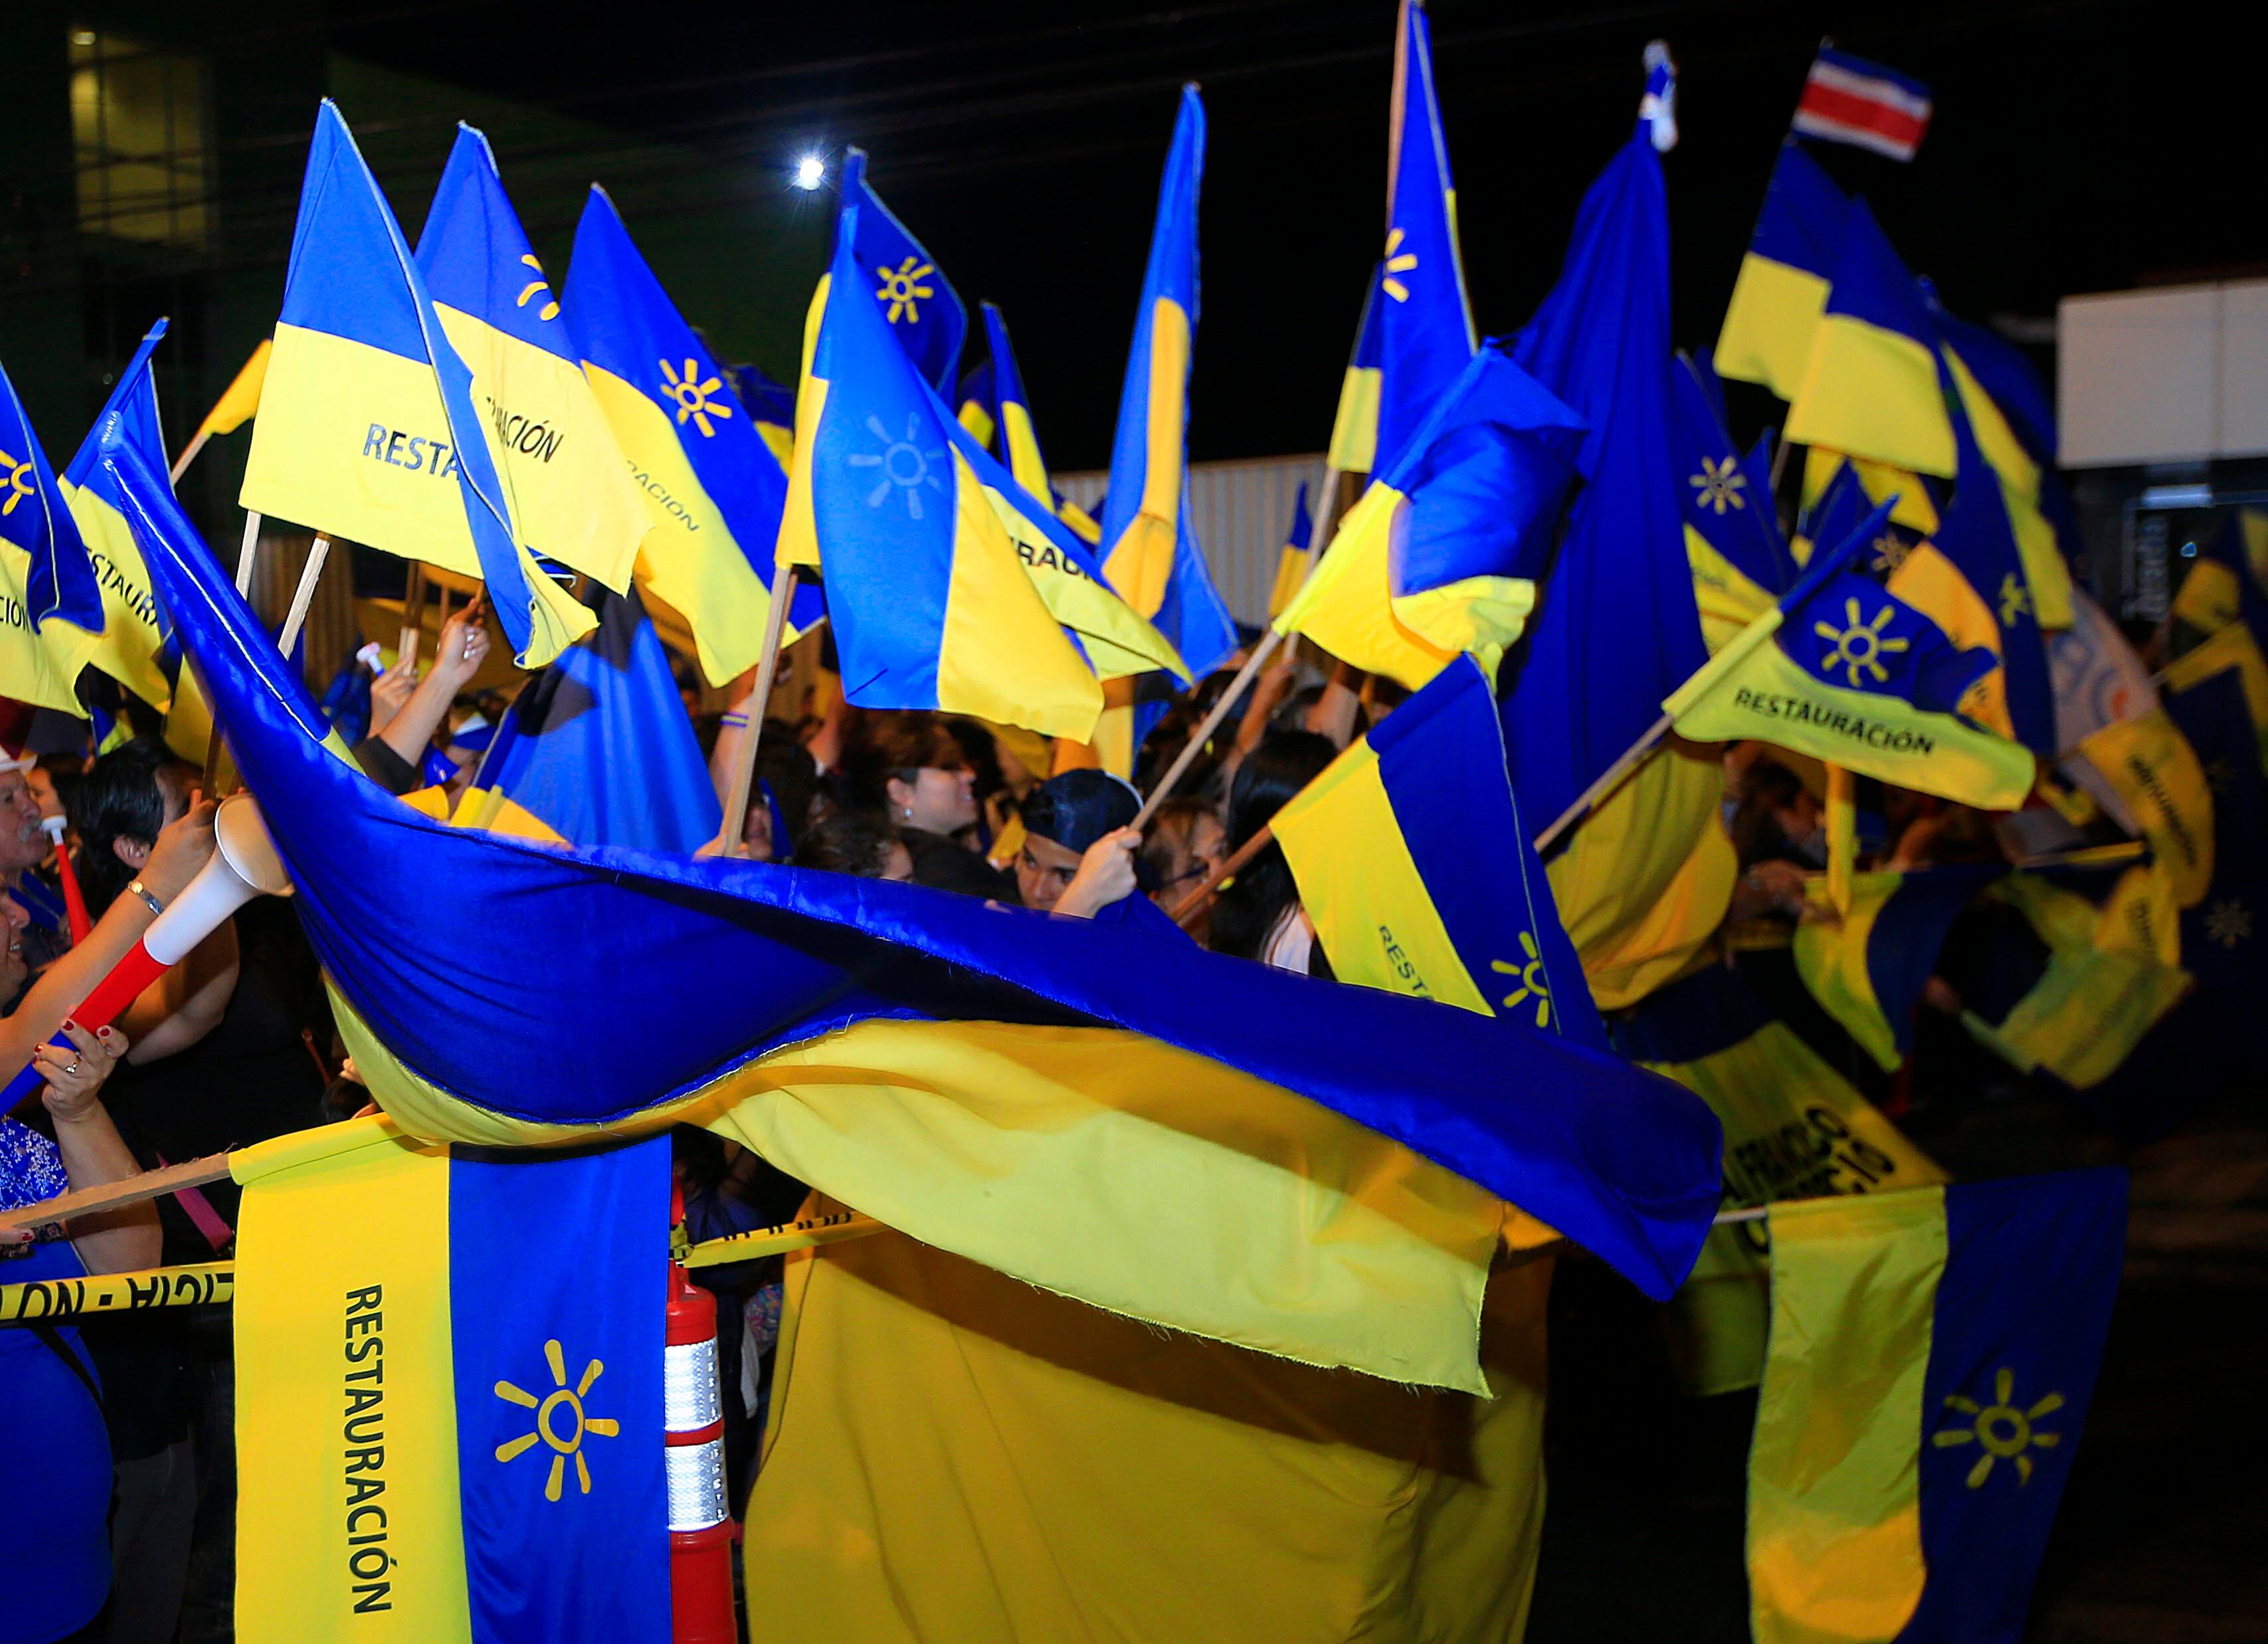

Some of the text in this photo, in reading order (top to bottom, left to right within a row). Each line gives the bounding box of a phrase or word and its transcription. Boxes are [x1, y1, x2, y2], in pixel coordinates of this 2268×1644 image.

[1734, 686, 1935, 754] RESTAURACIÓN
[1378, 925, 1434, 1000] REST
[343, 1284, 398, 1614] RESTAURACIÓN
